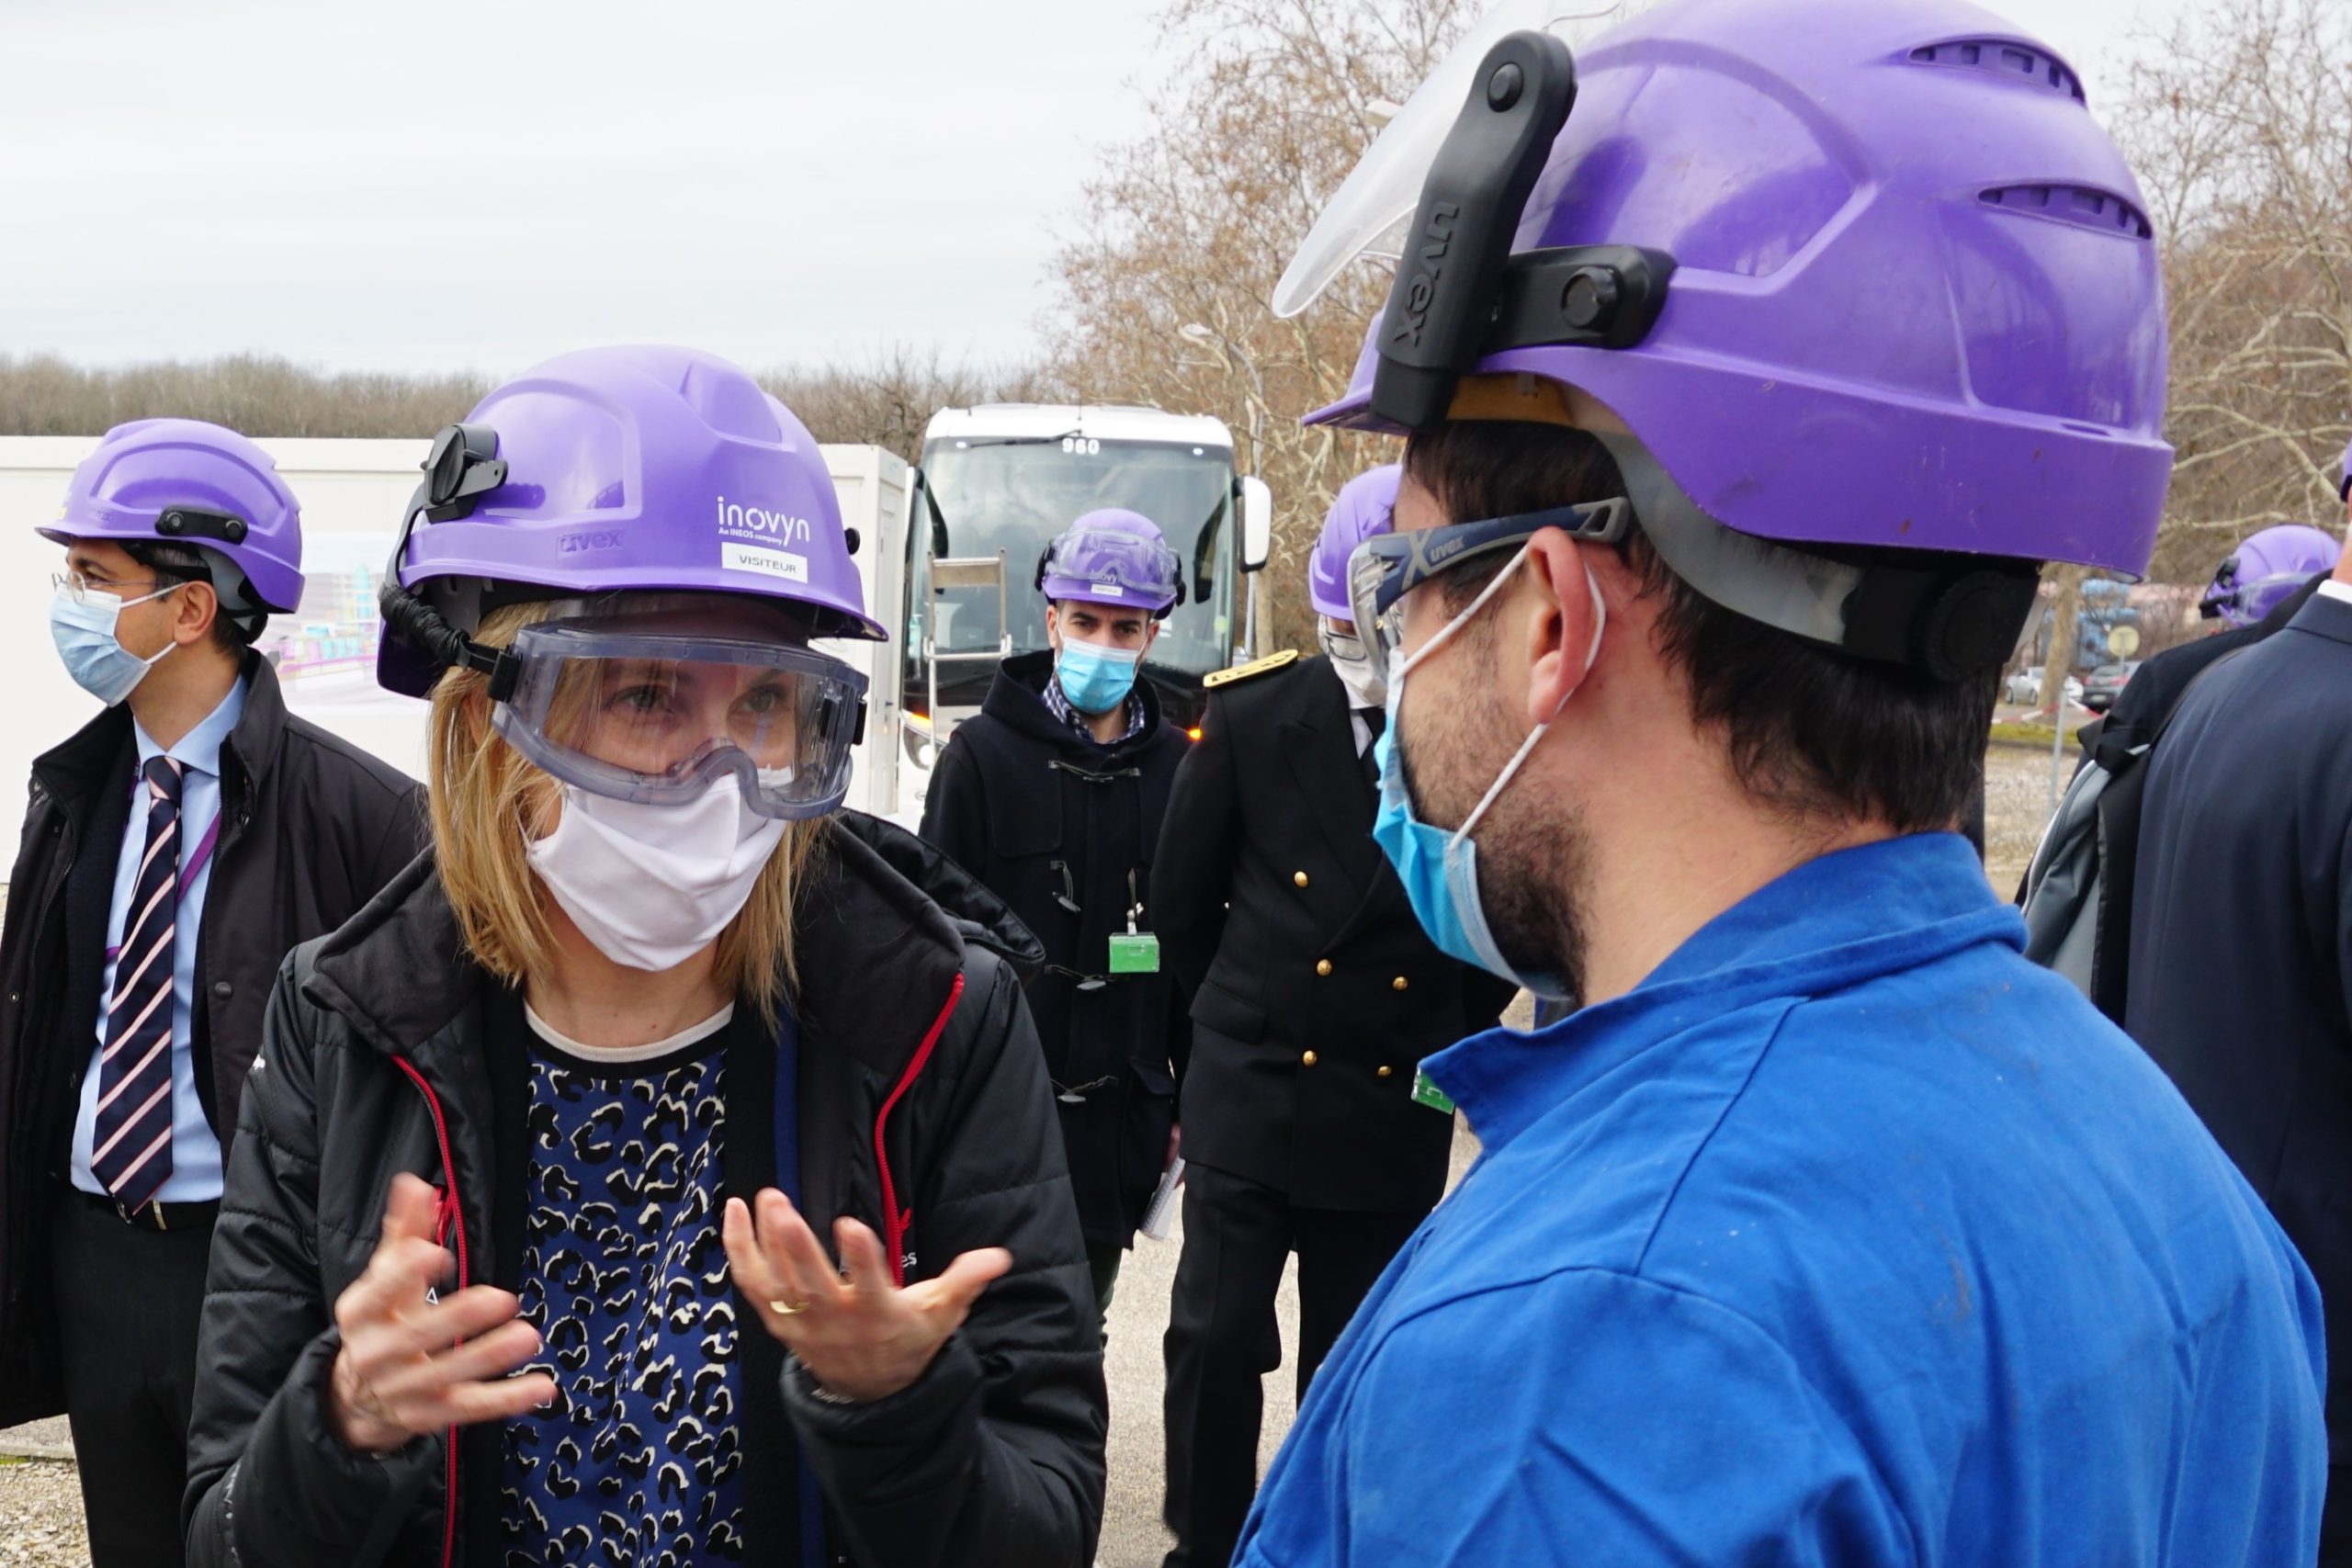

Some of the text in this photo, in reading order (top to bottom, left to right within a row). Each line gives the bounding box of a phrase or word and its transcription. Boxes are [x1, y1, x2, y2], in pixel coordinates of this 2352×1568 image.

[1393, 201, 1460, 347] uvex
[1062, 437, 1100, 455] 960
[718, 496, 809, 547] inovyn
[559, 531, 623, 552] uvex
[1430, 536, 1464, 562] uvex
[739, 555, 797, 573] VISITEUR
